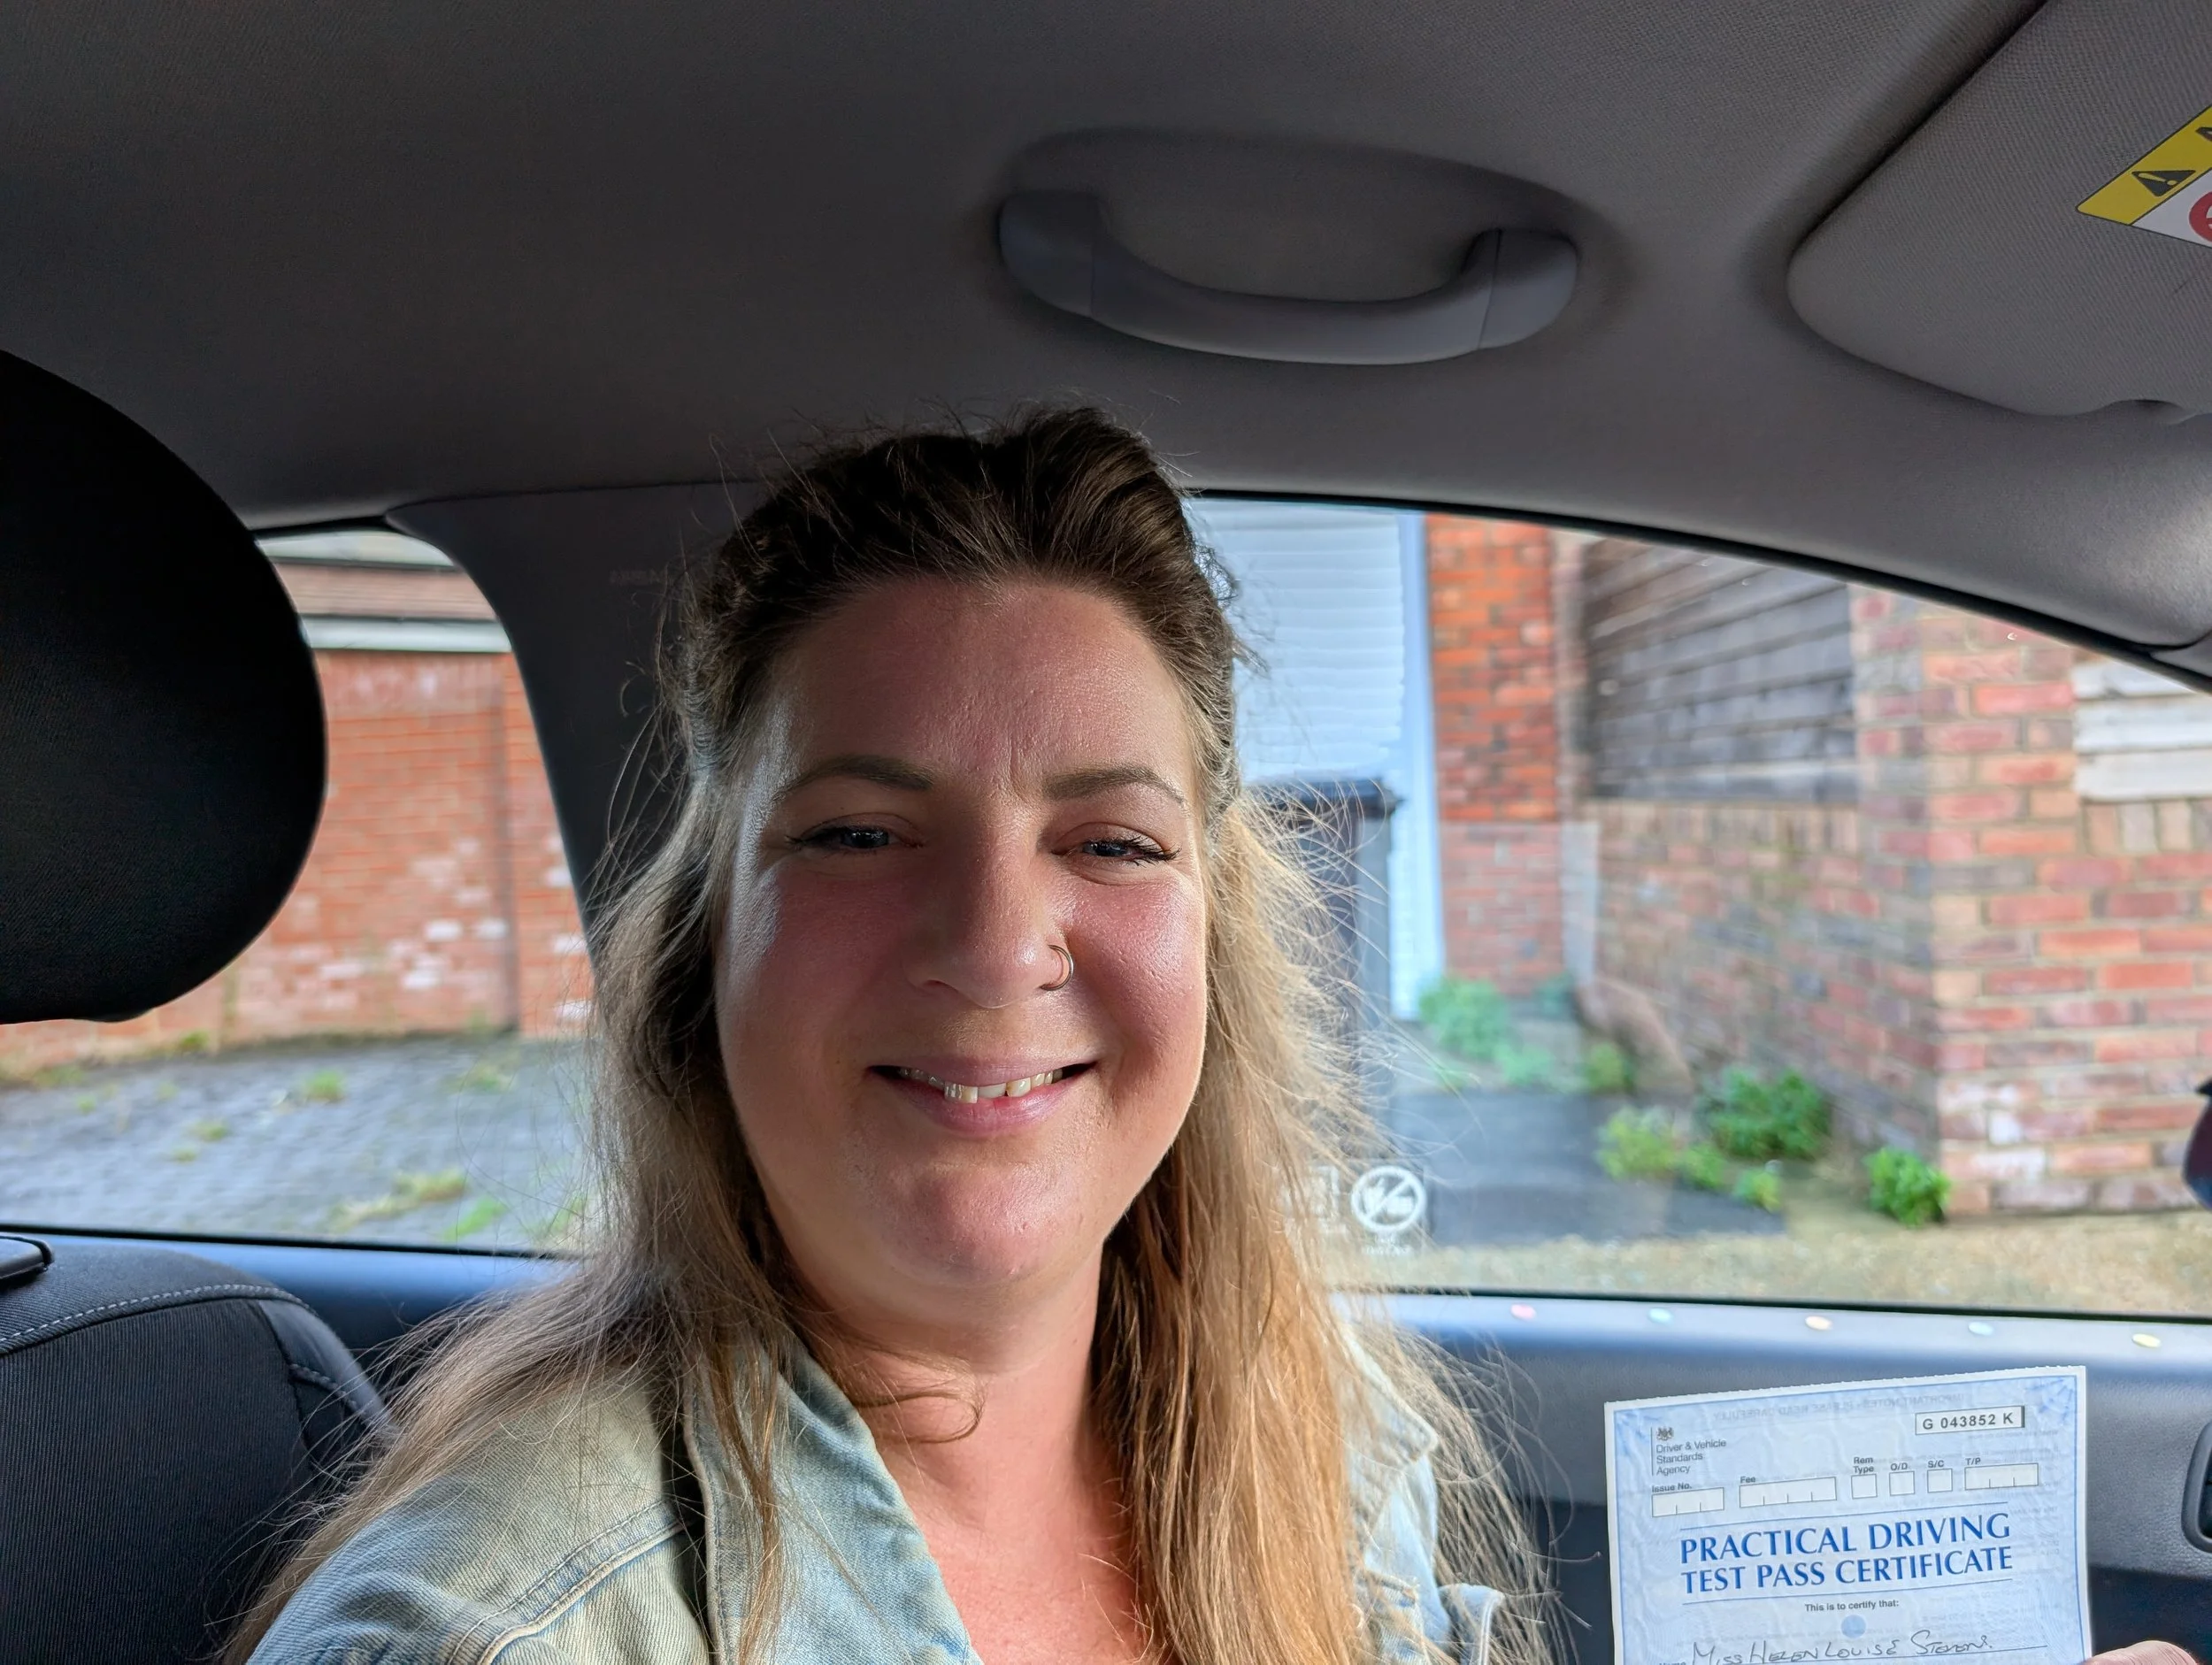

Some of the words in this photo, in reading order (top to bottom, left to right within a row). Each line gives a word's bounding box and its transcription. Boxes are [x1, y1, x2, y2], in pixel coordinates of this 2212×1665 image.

[1923, 1418, 1933, 1430] G
[1940, 1414, 1996, 1429] 043852
[2003, 1412, 2014, 1424] K
[1656, 1442, 1683, 1454] Driver
[1685, 1441, 1692, 1451] &
[1694, 1439, 1726, 1450] Vehicle
[1656, 1452, 1703, 1464] Standards
[1656, 1465, 1690, 1477] Agency
[1853, 1466, 1874, 1475] Type
[1890, 1462, 1908, 1471] O/D
[1652, 1484, 1675, 1492] Issue
[1678, 1482, 1692, 1491] No.
[1681, 1526, 1857, 1563] PRACTICAL
[1869, 1513, 2009, 1550] DRIVING
[1681, 1566, 1746, 1593] TEST
[1756, 1561, 1825, 1588] PASS
[1835, 1546, 2013, 1584] CERTIFICATE
[1805, 1603, 1824, 1612] This
[1848, 1600, 1876, 1610] certify
[1878, 1599, 1900, 1607] that:
